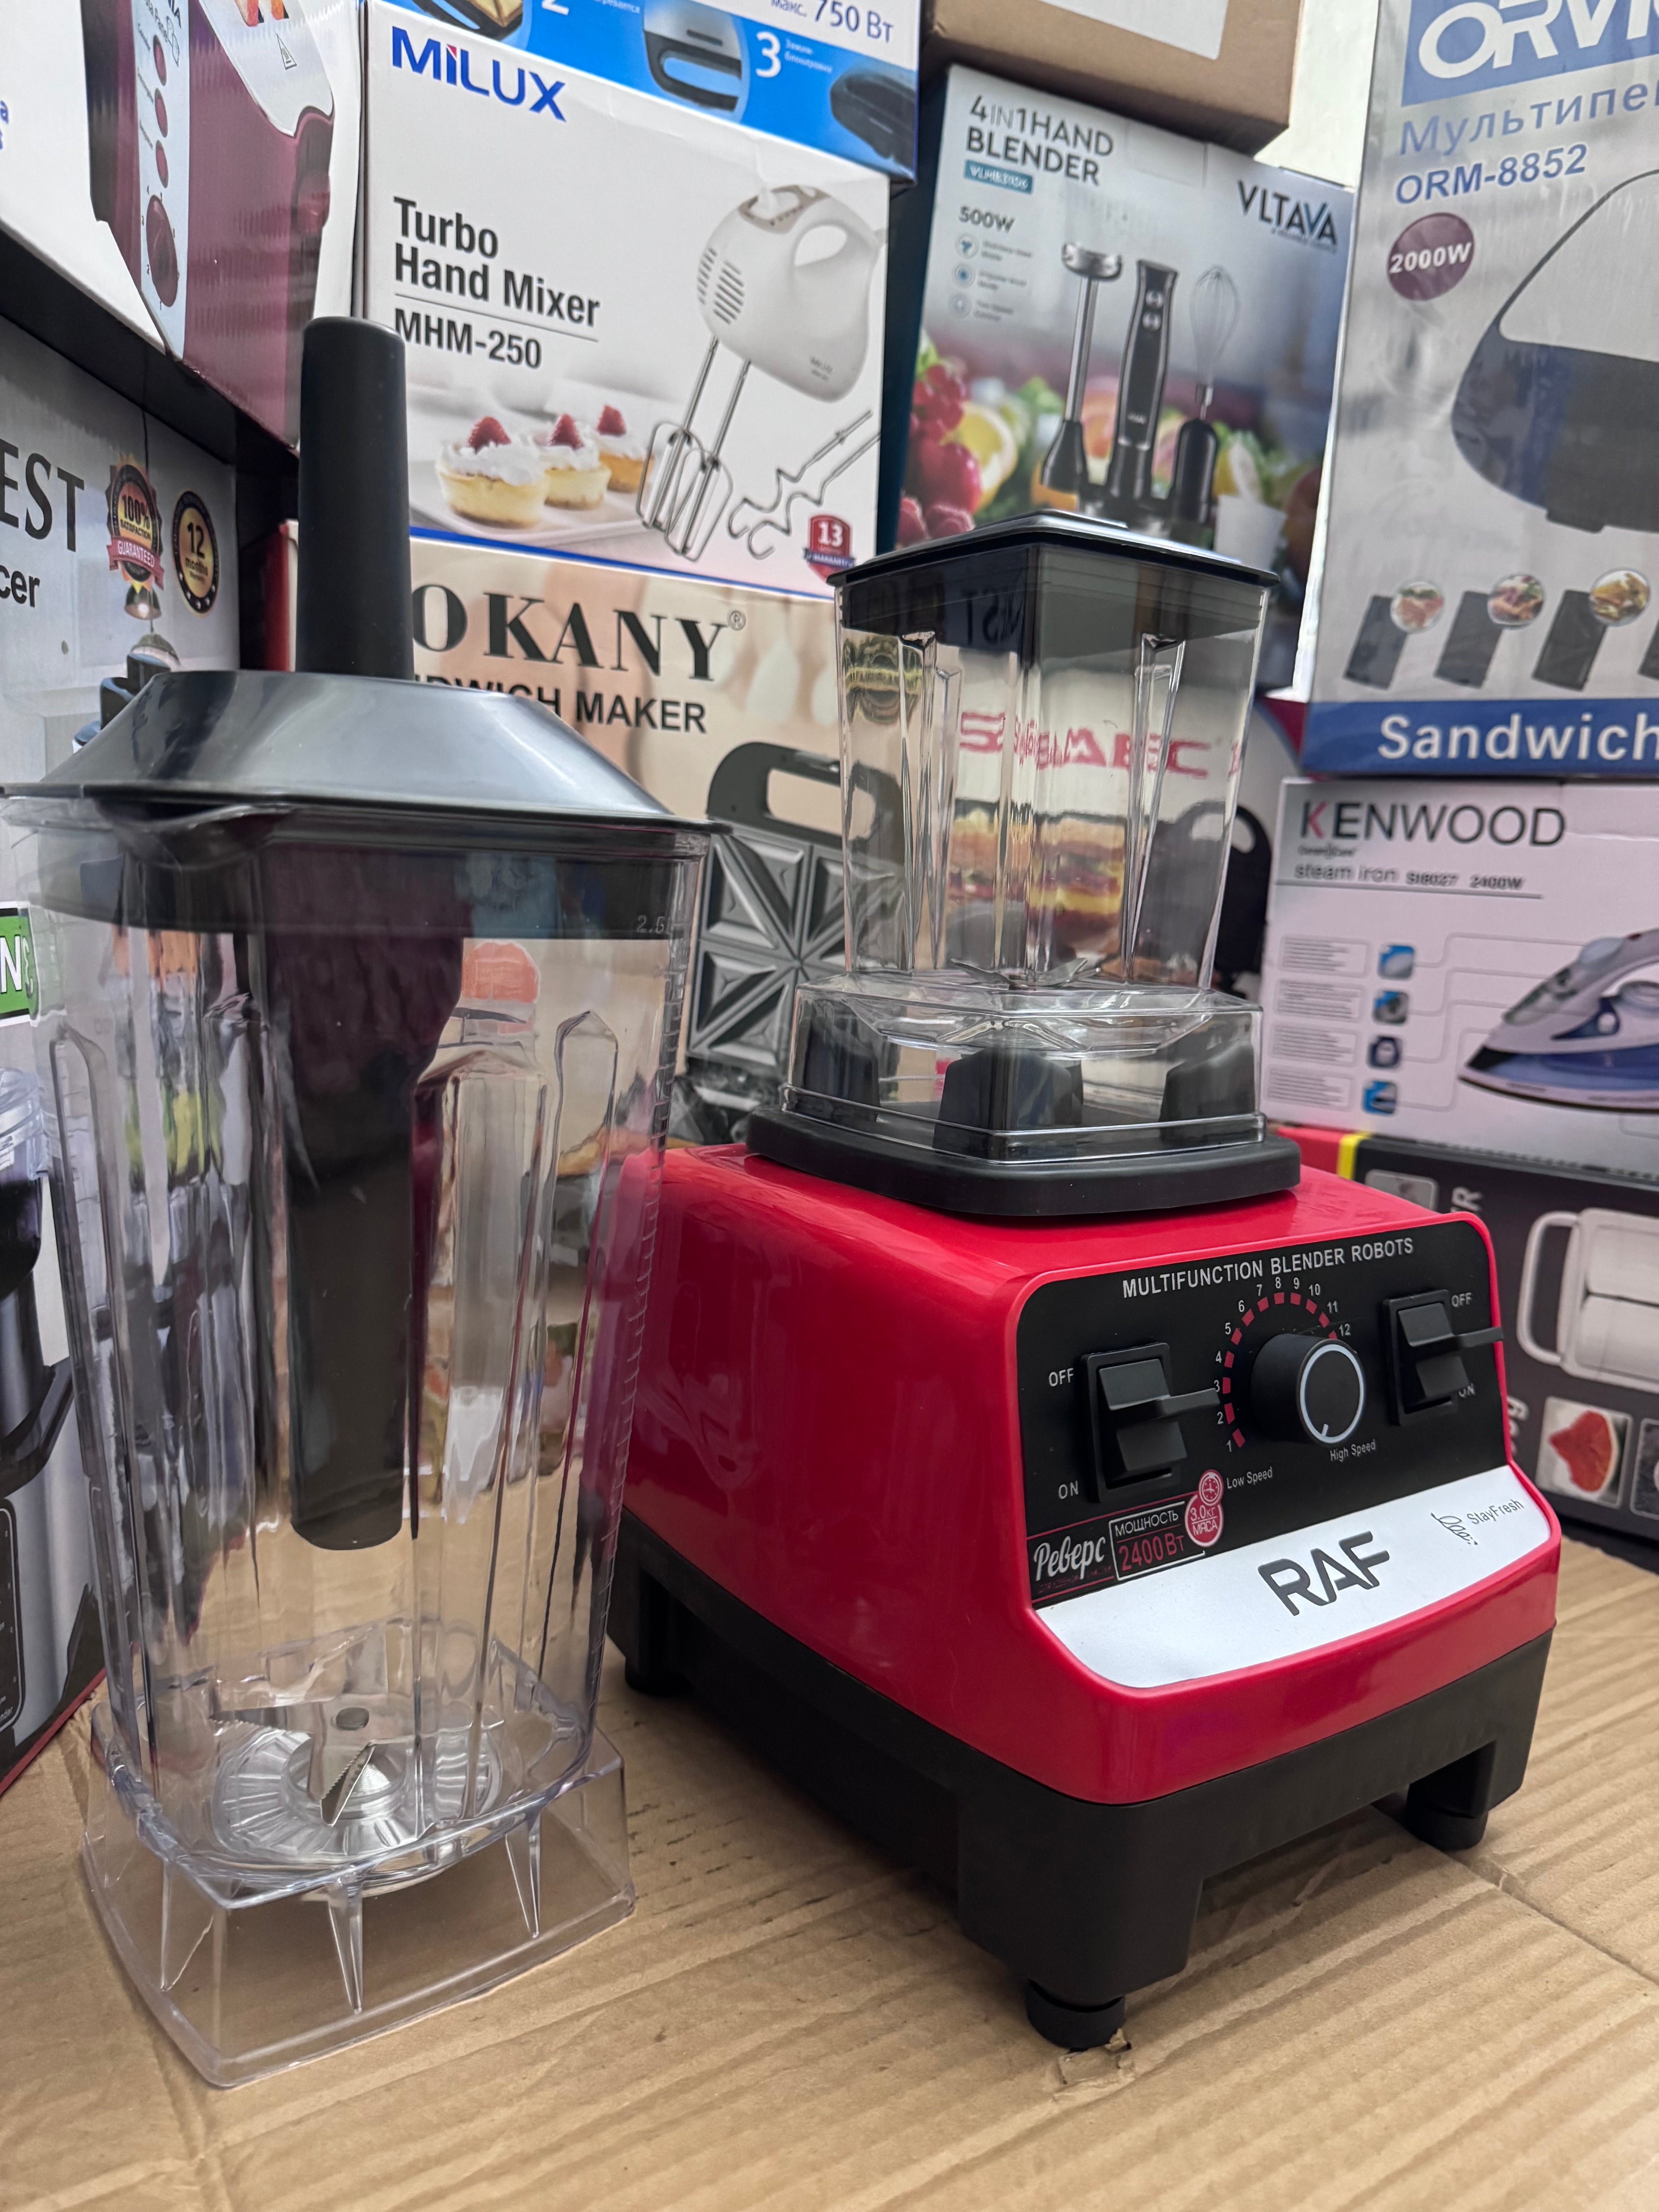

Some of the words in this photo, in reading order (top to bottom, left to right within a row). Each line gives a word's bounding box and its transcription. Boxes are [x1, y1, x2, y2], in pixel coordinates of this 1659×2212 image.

[815, 0, 860, 32] 750
[867, 10, 894, 43] Вт
[1419, 0, 1659, 79] ORVI
[756, 32, 781, 78] 3
[1399, 80, 1659, 156] Мультипе
[966, 125, 1100, 186] BLENDER
[1395, 143, 1587, 205] ORM-8852
[958, 206, 1016, 233] 500W
[1238, 180, 1337, 245] VLTAVA
[394, 196, 499, 259] Turbo
[1389, 242, 1471, 274] 2000W
[395, 242, 490, 302] Hand
[503, 269, 600, 327] Mixer
[394, 308, 542, 369] MHM-250
[121, 494, 151, 530] 100%
[187, 522, 206, 559] 12
[818, 521, 843, 547] 13
[118, 540, 155, 568] GUARANTEED
[185, 557, 208, 577] months
[576, 690, 708, 734] MAKER
[1378, 712, 1659, 760] Sandwich
[1300, 800, 1567, 847] KENWOOD
[1296, 864, 1352, 880] steam
[1358, 865, 1398, 883] iron
[1470, 874, 1525, 890] 2400W
[1123, 1260, 1263, 1298] MULTIFUNCTION
[1271, 1248, 1345, 1275] BLENDER
[1352, 1237, 1414, 1262] ROBOTS
[1256, 1284, 1263, 1297] 7
[1275, 1276, 1281, 1289] 8
[1293, 1277, 1300, 1290] 9
[1308, 1284, 1321, 1296] 10
[1238, 1300, 1245, 1313] 6
[1327, 1300, 1338, 1313] 11
[1451, 1292, 1472, 1308] OFF
[1224, 1322, 1231, 1335] 5
[1339, 1323, 1351, 1337] 12
[1215, 1351, 1222, 1363] 4
[1049, 1368, 1074, 1387] OFF
[1214, 1379, 1220, 1392] 3
[1217, 1411, 1224, 1424] 2
[1226, 1440, 1232, 1452] 1
[1330, 1446, 1349, 1462] High
[1351, 1440, 1376, 1460] Speed
[1058, 1480, 1079, 1499] ON
[1226, 1474, 1245, 1490] Low
[1247, 1466, 1273, 1486] Speed
[1115, 1510, 1179, 1537] МОЩНОСТЬ
[1467, 1499, 1525, 1525] StayFresh
[1192, 1521, 1218, 1536] МЯСА
[1033, 1535, 1106, 1581] Реверс
[1258, 1531, 1390, 1616] RAF
